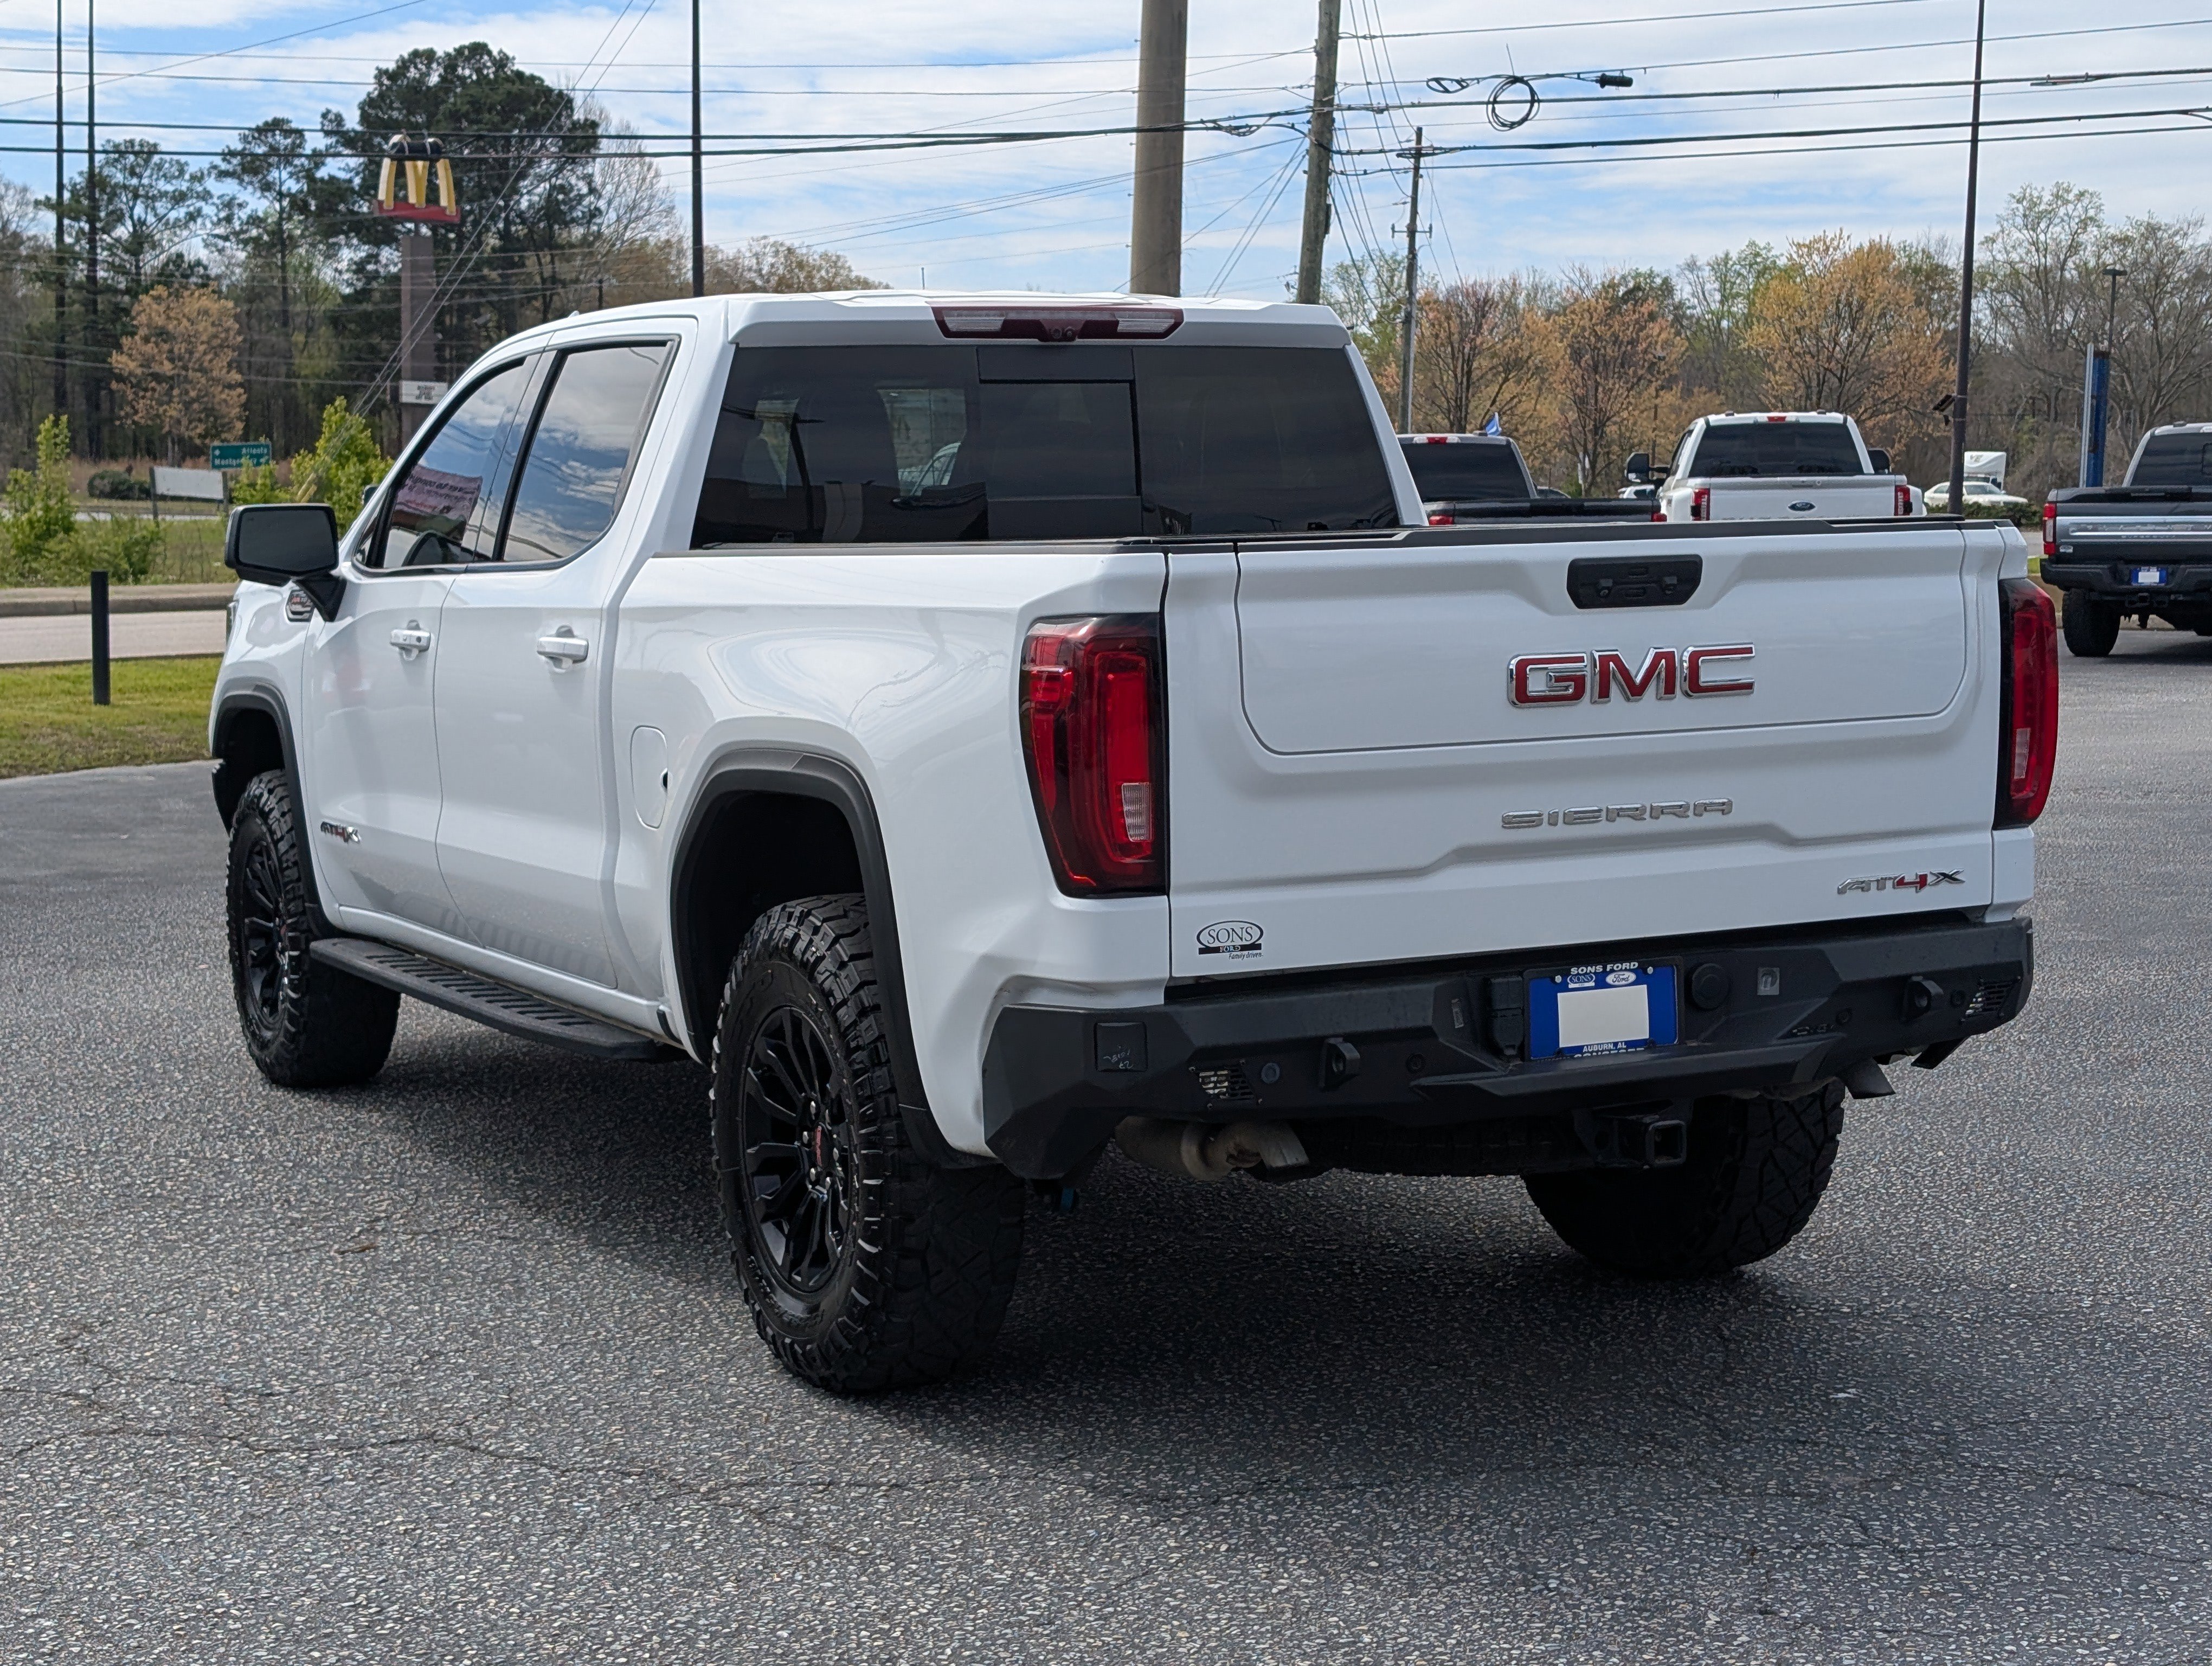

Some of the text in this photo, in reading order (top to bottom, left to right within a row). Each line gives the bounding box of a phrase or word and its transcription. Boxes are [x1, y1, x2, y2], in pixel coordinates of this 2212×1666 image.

[1507, 642, 1756, 707] GMC
[1502, 798, 1733, 829] SIERRA
[1837, 869, 1966, 895] AT4X
[1207, 926, 1253, 944] SONS
[1571, 962, 1638, 975] SONS FORD
[1612, 973, 1630, 983] Ford
